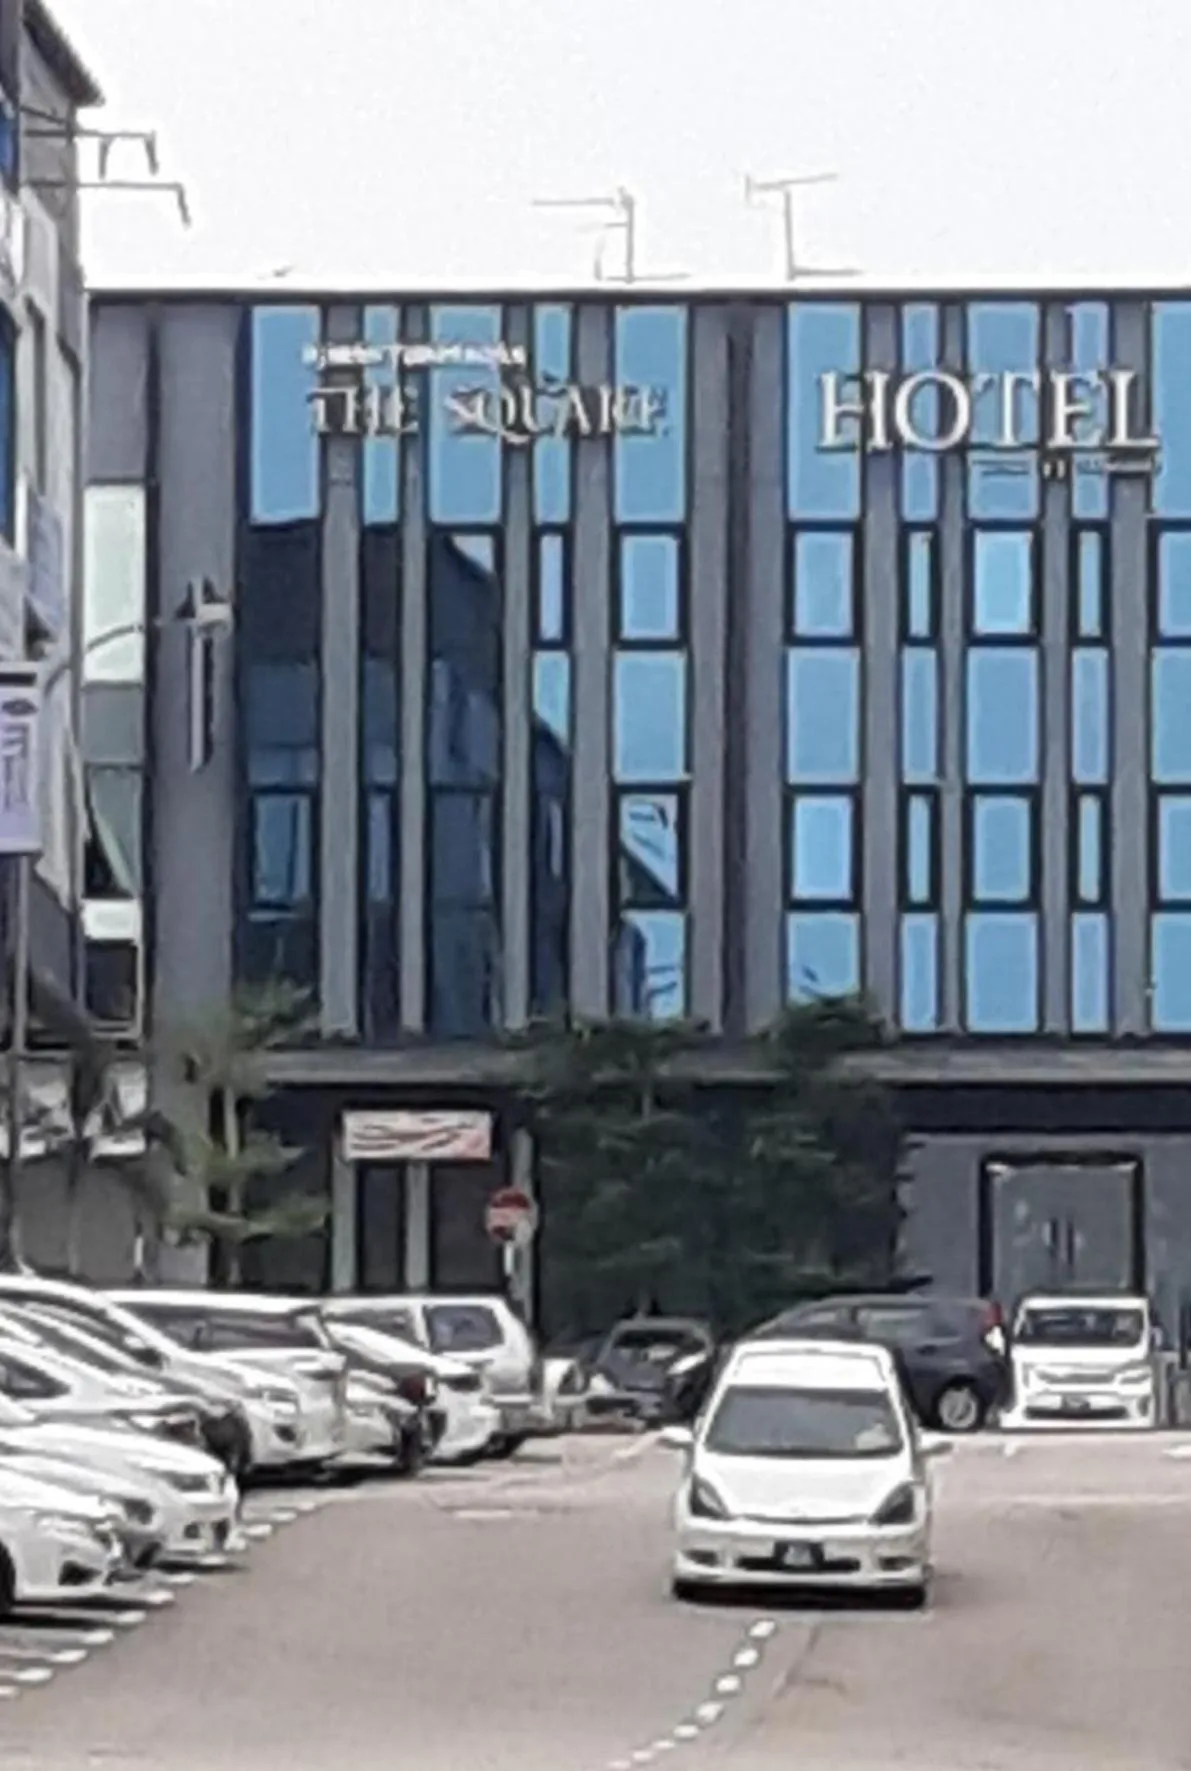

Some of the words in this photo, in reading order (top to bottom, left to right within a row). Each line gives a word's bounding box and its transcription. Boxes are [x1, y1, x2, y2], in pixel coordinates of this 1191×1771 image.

[307, 385, 420, 437] THE
[444, 383, 670, 445] SQUARE
[817, 368, 1161, 451] HOTEL
